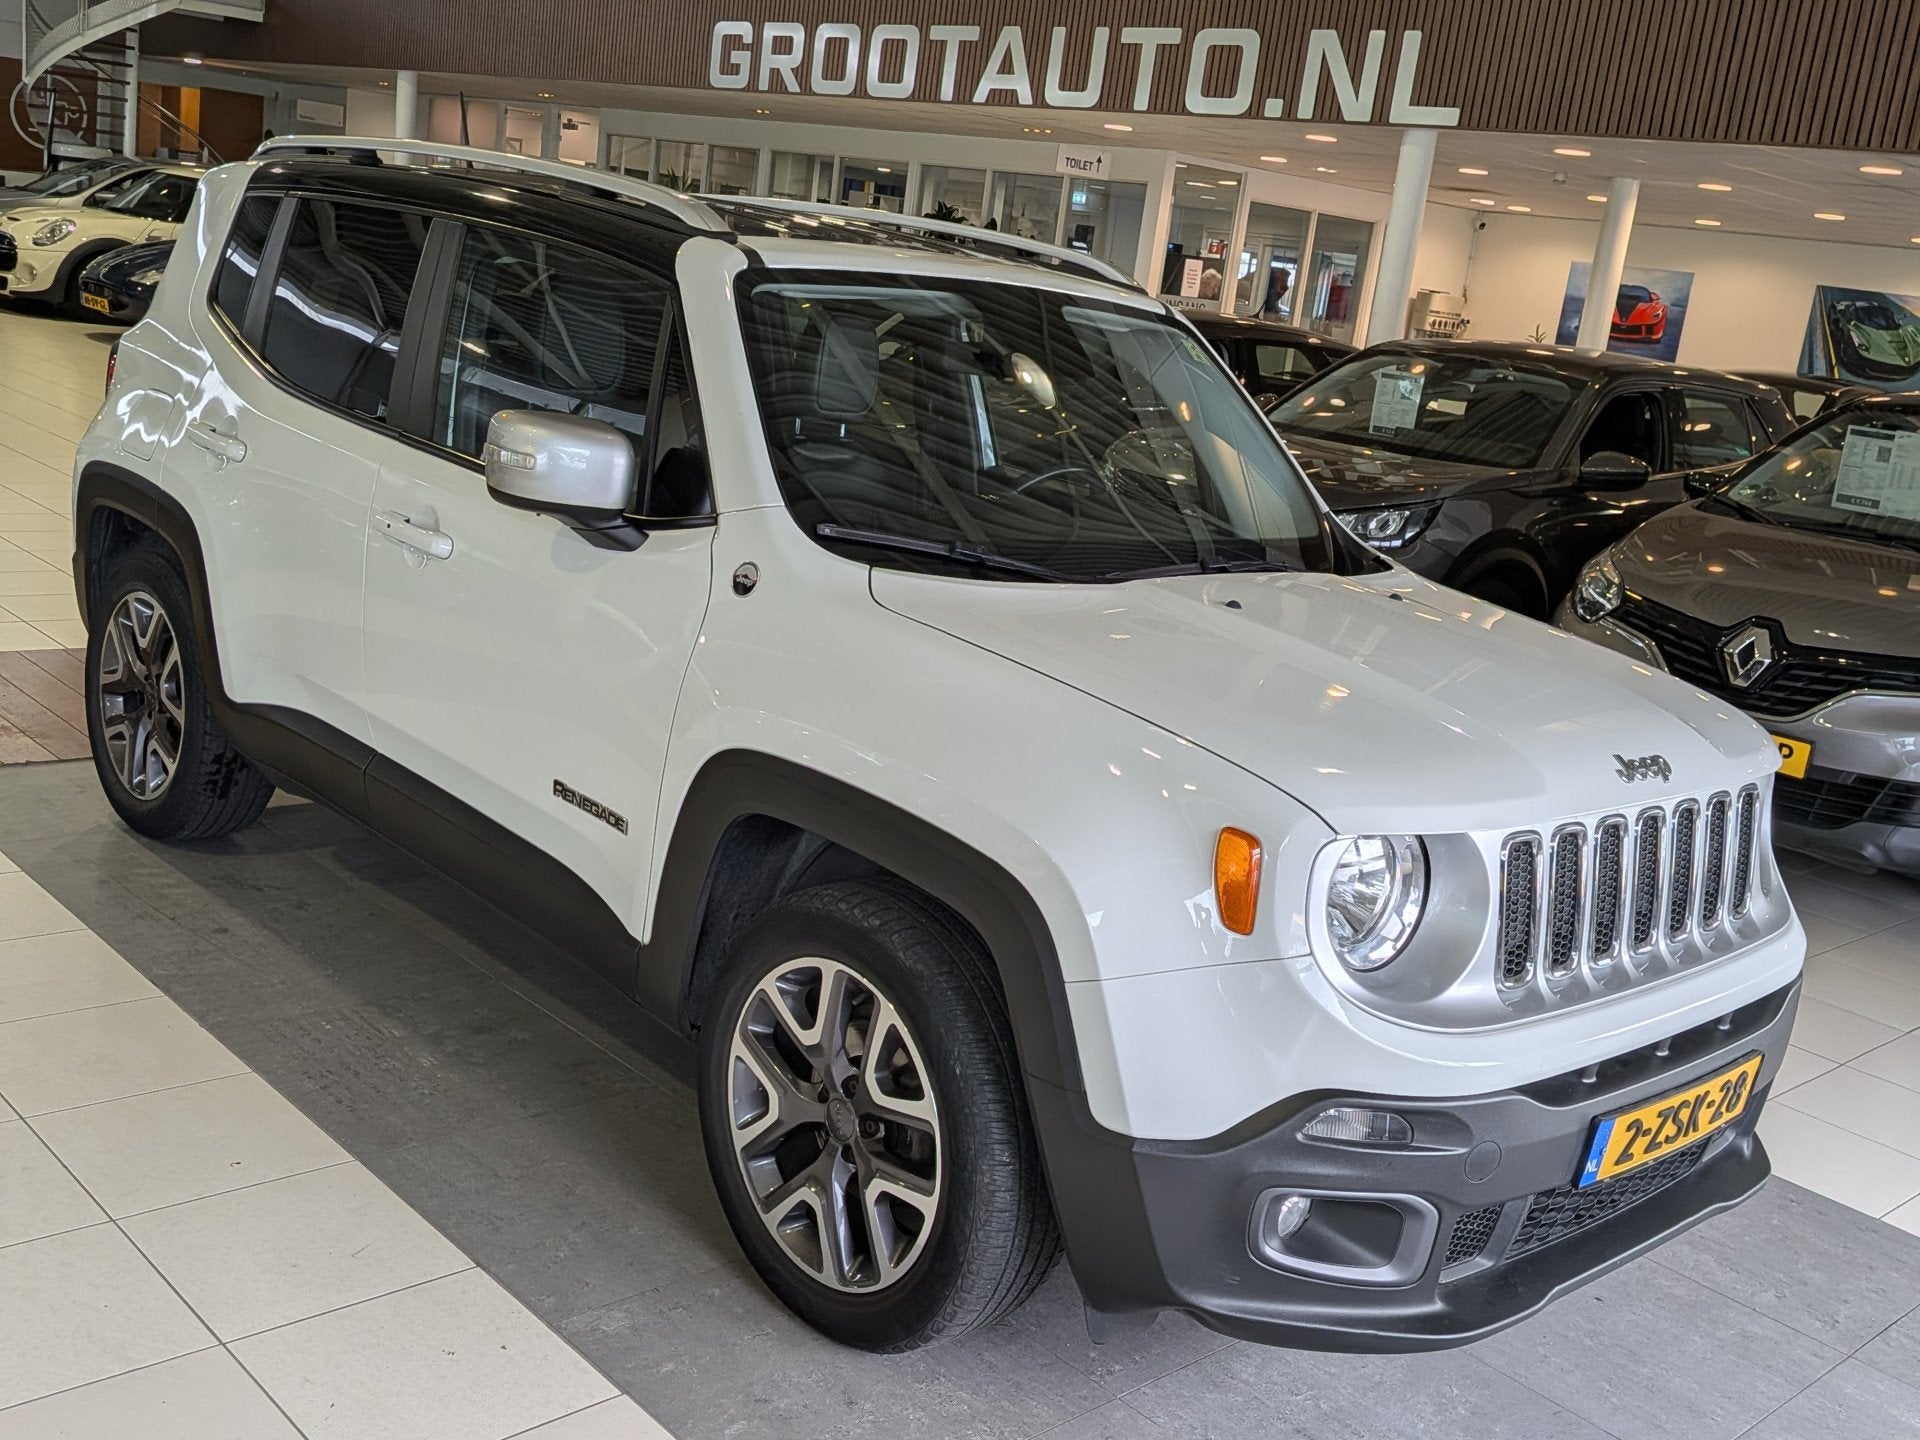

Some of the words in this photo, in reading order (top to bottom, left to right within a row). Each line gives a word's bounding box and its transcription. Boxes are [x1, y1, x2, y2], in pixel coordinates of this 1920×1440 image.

[709, 20, 1460, 127] GROOTAUTO.NL
[1065, 156, 1094, 172] TOILET
[735, 575, 753, 588] Jeep
[1612, 754, 1672, 784] Jeep
[553, 778, 629, 836] RENEGADE
[1584, 1158, 1598, 1175] NL
[1614, 1070, 1749, 1167] 2-ZSK-28
